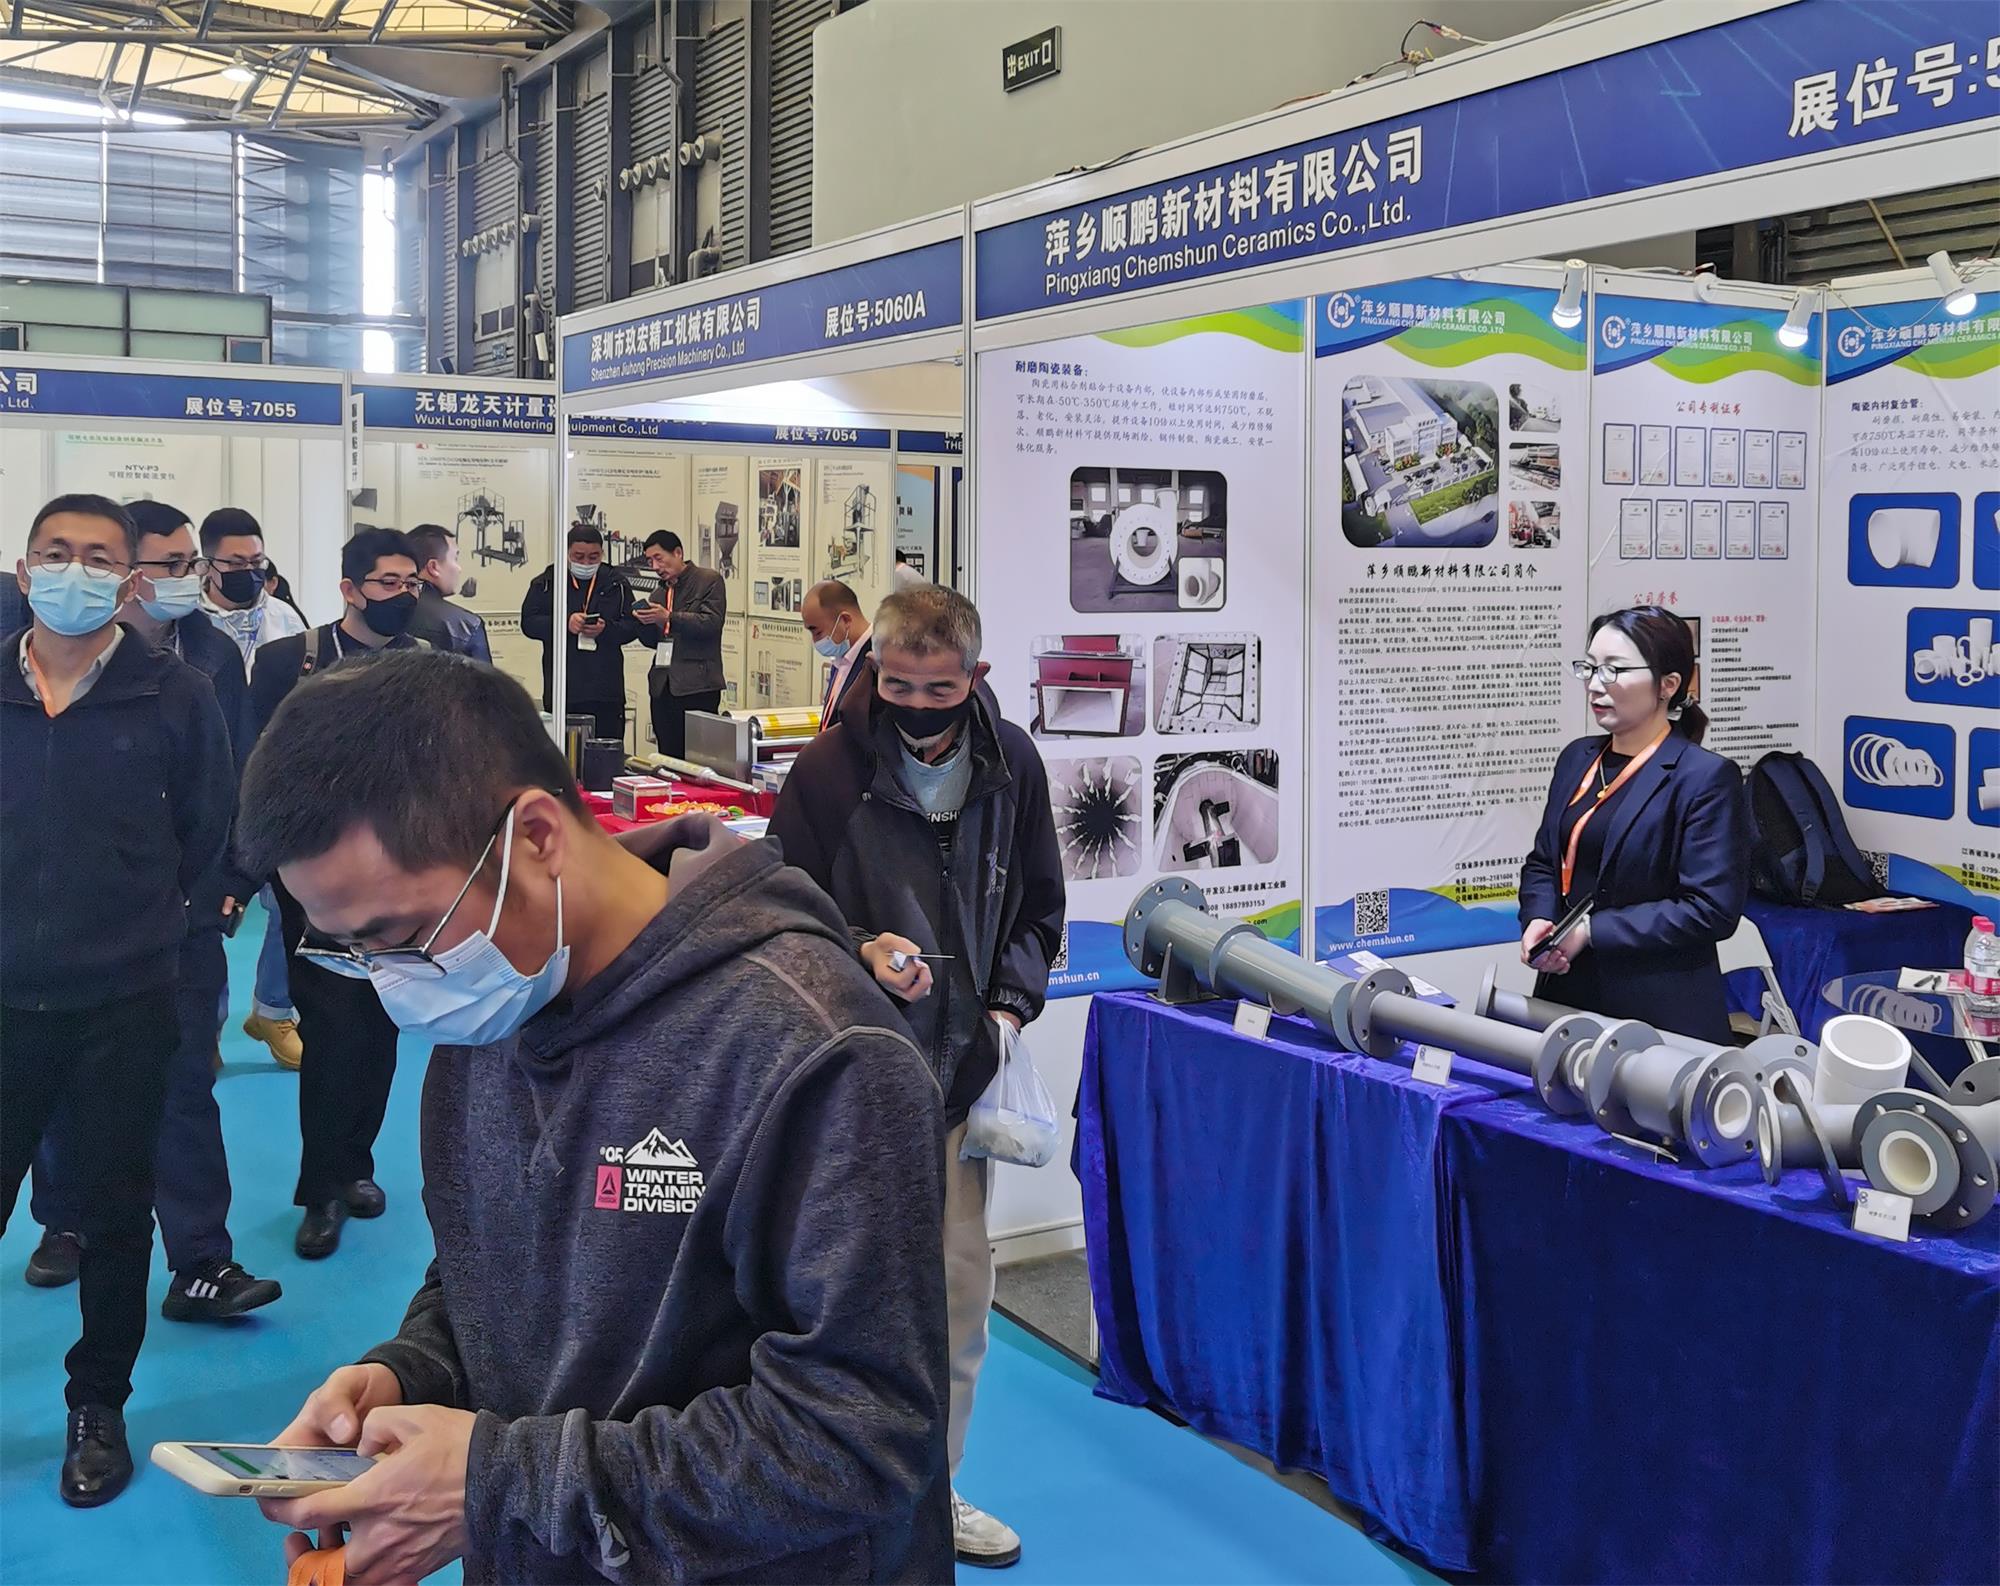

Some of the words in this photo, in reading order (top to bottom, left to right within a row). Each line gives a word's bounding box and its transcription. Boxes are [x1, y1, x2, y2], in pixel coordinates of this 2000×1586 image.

[1018, 48, 1040, 72] EXIT
[1045, 125, 1423, 267] 萍乡顺鹏新材料有限公司
[1046, 263, 1122, 296] Pingxiang
[1124, 242, 1218, 279] Chemshun
[1223, 221, 1317, 259] Ceramics
[824, 290, 926, 340] 展位号:5060A
[590, 296, 761, 363] 深圳市玖宏精工机械有限公司
[590, 364, 621, 383] Shenzhen
[621, 359, 645, 378] Jiuhong
[645, 355, 677, 374] Precision
[677, 348, 715, 367] Machinery
[185, 397, 297, 418] 展位号:7055
[415, 414, 445, 425] Wuxi
[447, 415, 495, 430] Longtian
[502, 418, 554, 433] Metering
[568, 422, 616, 434] uipment
[1366, 562, 1538, 579] 萍乡顺鹏新材料有限公司简介
[1329, 932, 1416, 952] www.chemshun.cn
[626, 1168, 704, 1185] WINTER
[624, 1183, 706, 1199] TRAININ
[623, 1197, 699, 1213] DIVISIO
